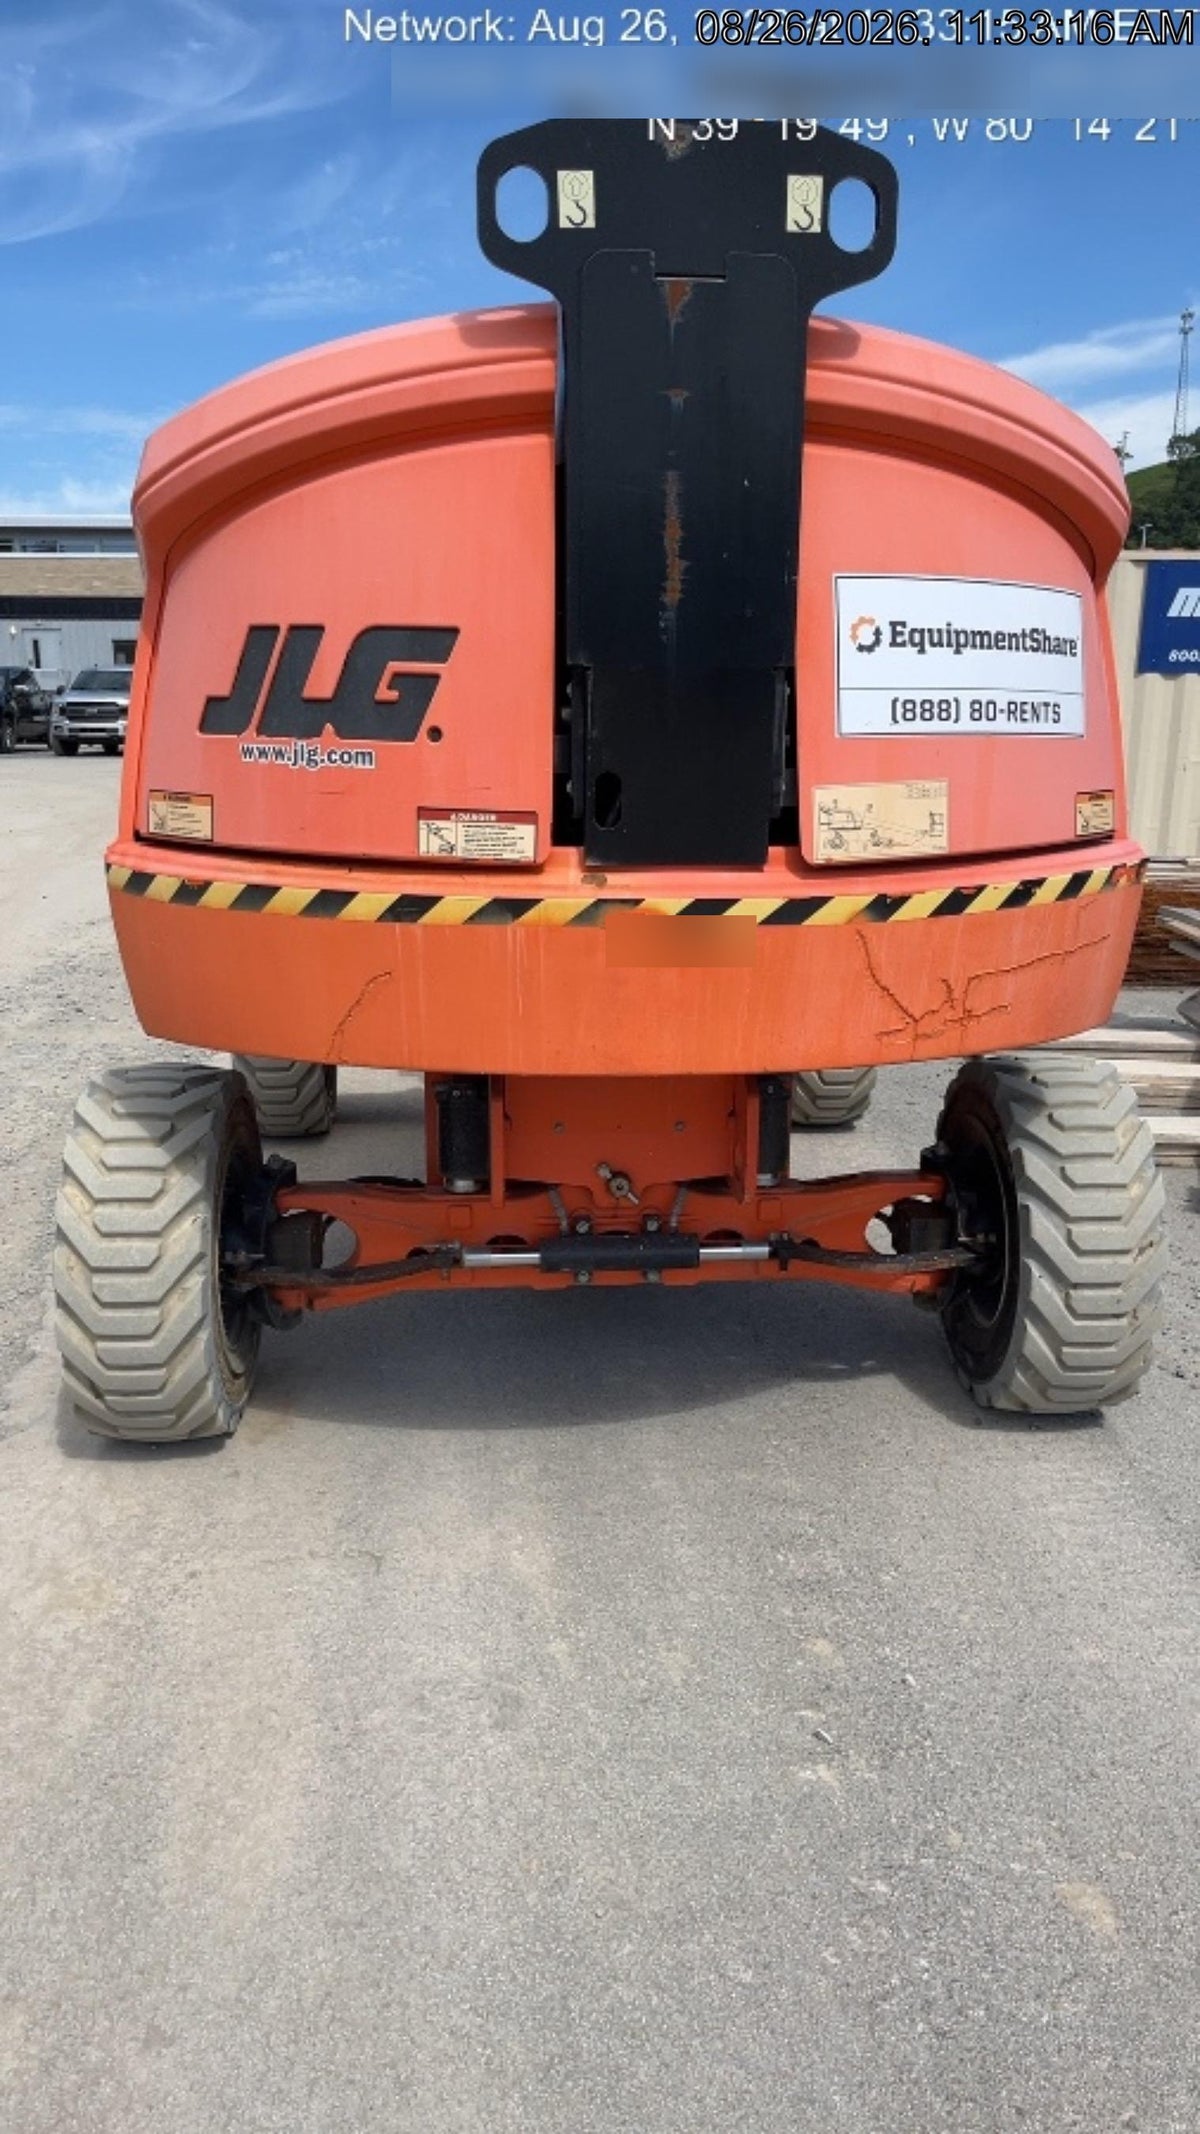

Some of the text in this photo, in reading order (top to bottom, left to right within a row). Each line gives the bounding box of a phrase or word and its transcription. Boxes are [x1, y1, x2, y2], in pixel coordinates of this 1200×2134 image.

[889, 620, 1078, 657] EquipmentShare
[198, 624, 460, 742] JLG
[891, 697, 1062, 724] (888) 80-RENTS
[239, 743, 375, 768] www.jlg.com
